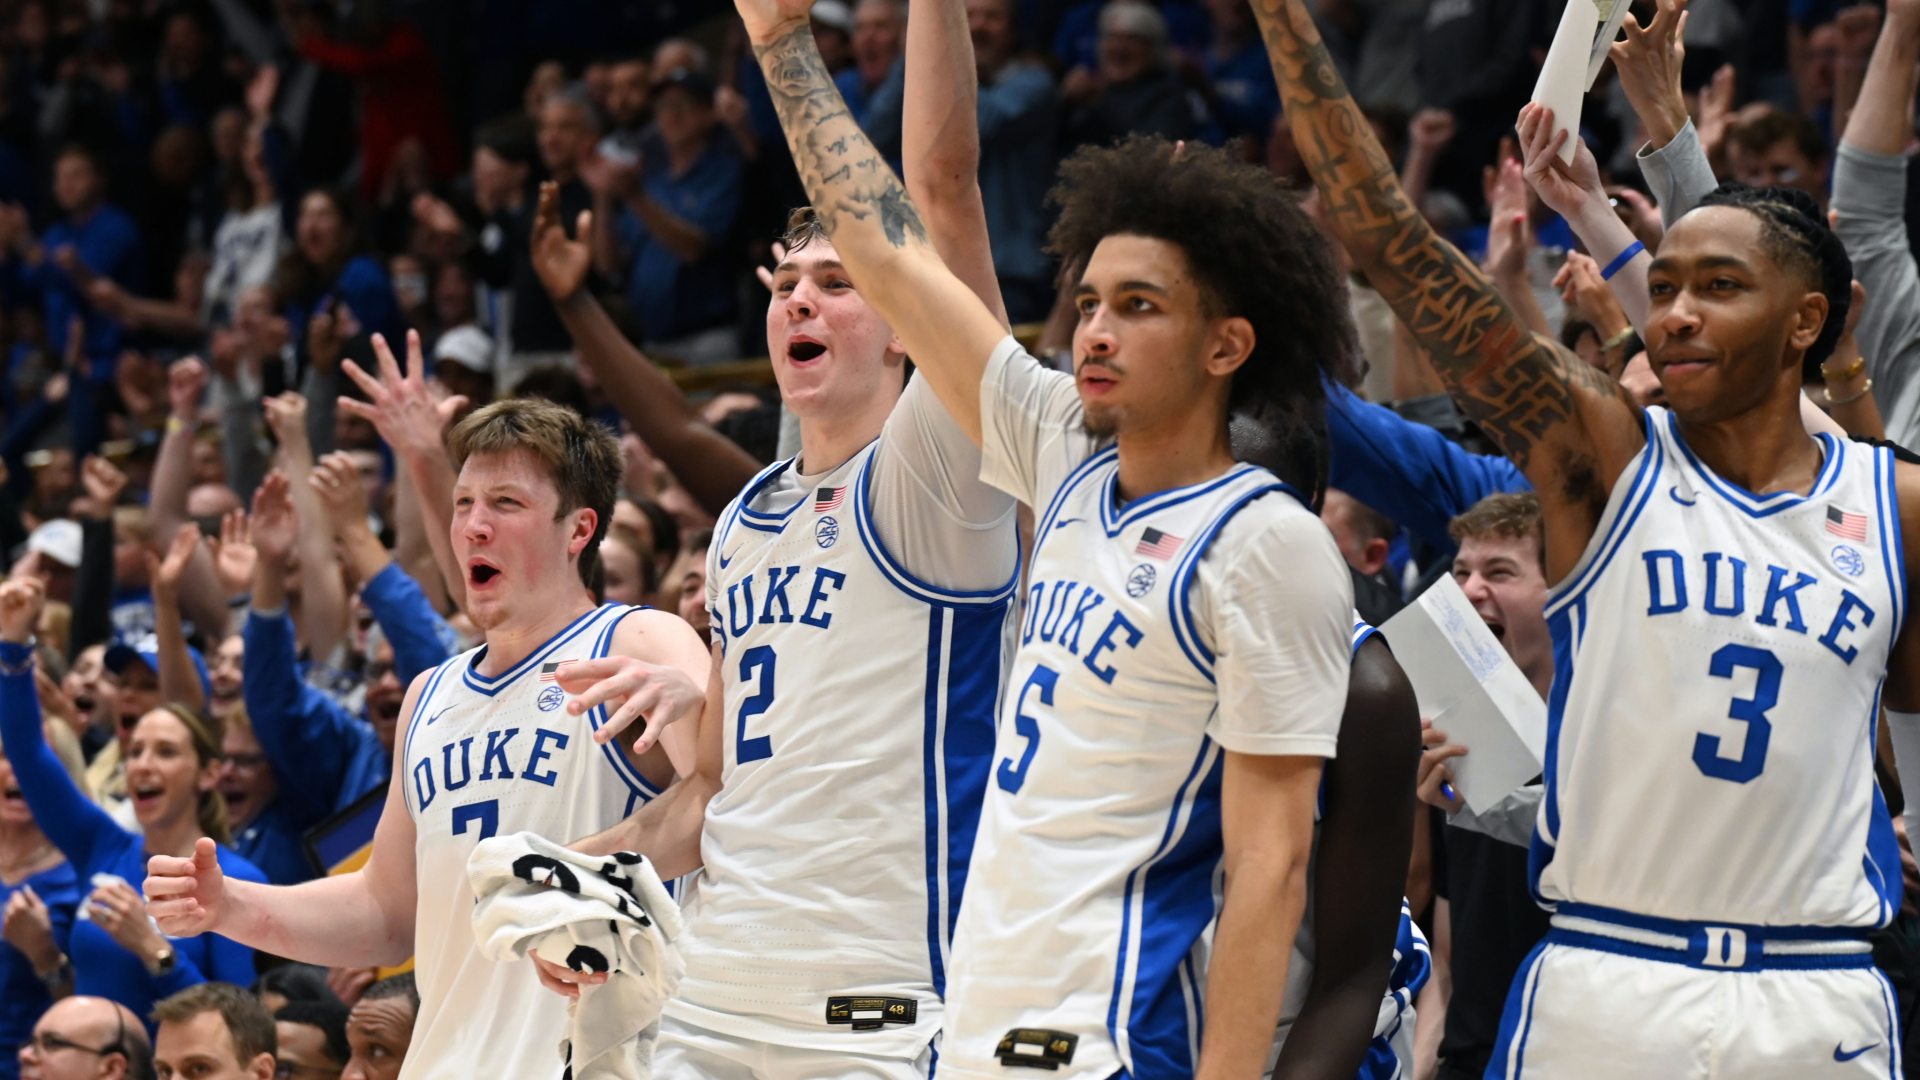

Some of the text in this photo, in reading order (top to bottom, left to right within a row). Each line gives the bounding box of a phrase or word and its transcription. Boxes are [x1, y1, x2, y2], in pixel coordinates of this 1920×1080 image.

[1023, 580, 1145, 685] DUKE
[1642, 549, 1875, 665] DUKE
[736, 644, 777, 765] 2
[997, 663, 1060, 796] 5
[1692, 643, 1784, 784] 3
[414, 727, 569, 813] DUKE
[1702, 926, 1747, 967] D
[888, 1004, 905, 1015] 48
[1050, 1039, 1069, 1054] 48
